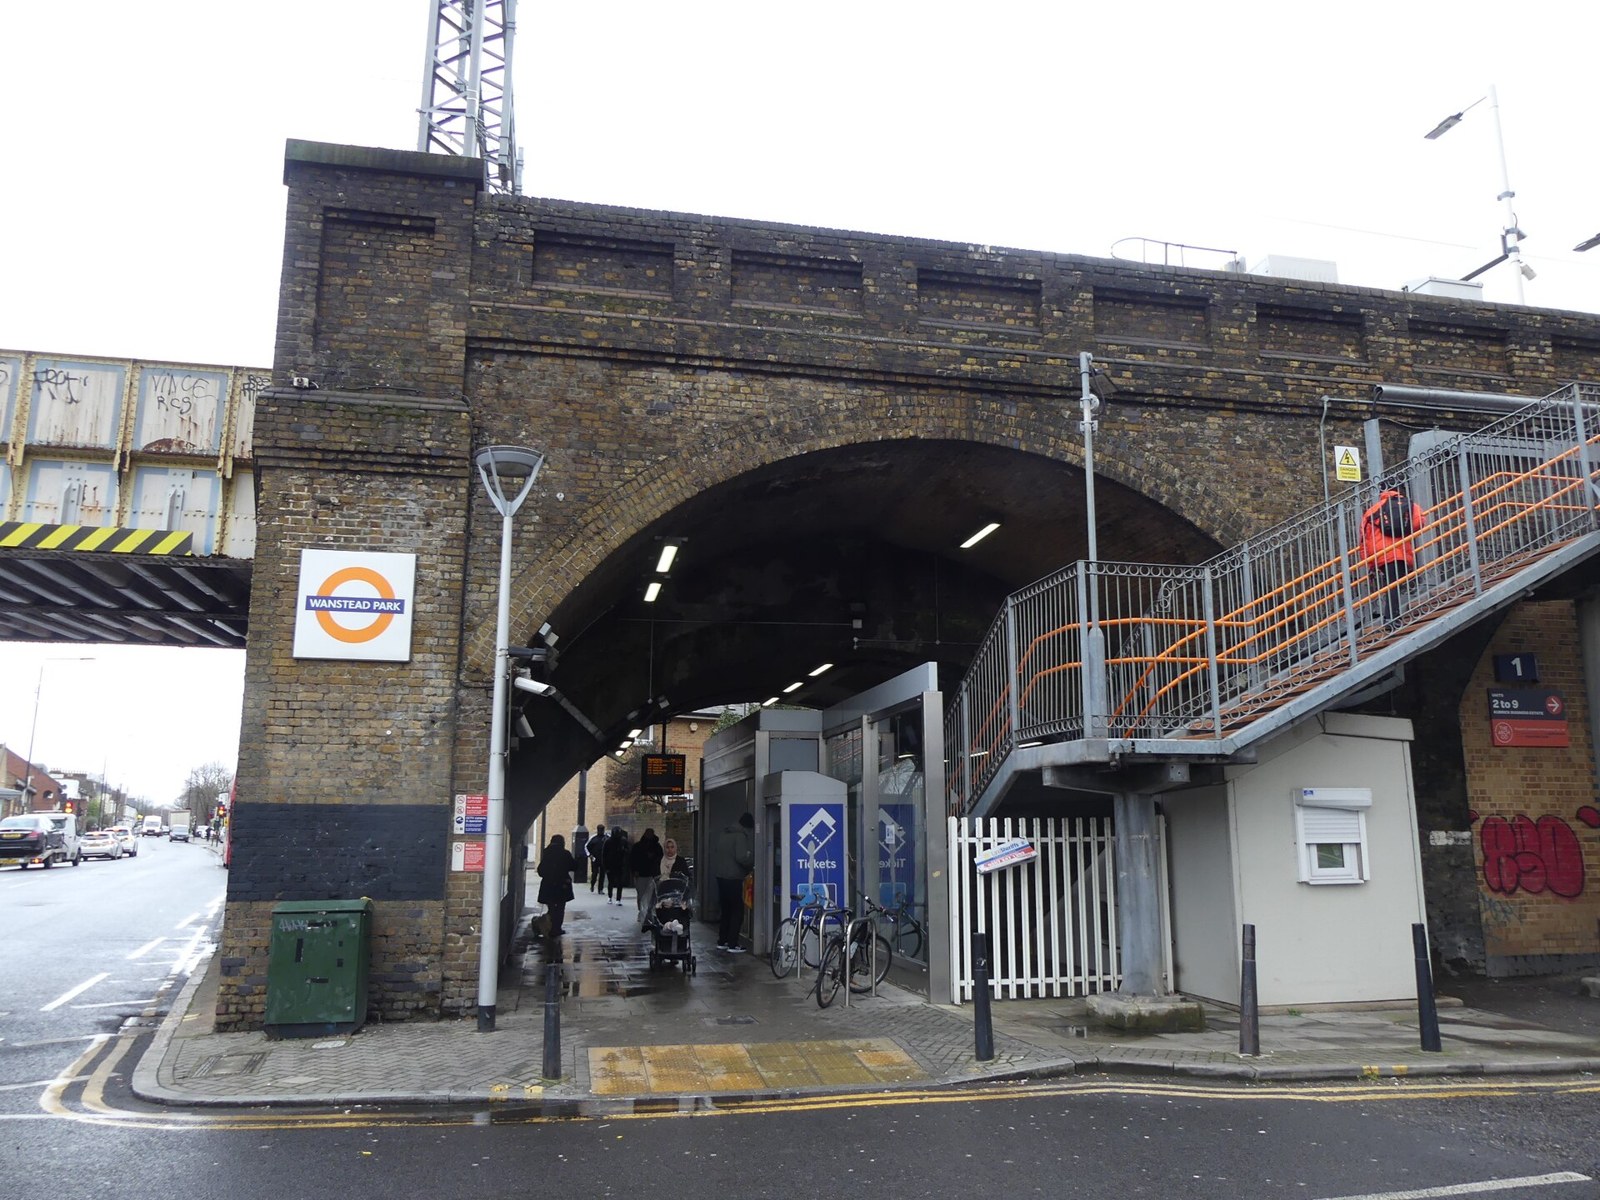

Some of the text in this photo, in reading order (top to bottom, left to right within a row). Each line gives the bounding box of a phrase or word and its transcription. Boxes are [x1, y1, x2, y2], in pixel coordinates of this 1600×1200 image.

[309, 598, 401, 611] WANSTEAD PARK
[1511, 657, 1523, 676] 1
[1492, 699, 1519, 709] 2 to 9
